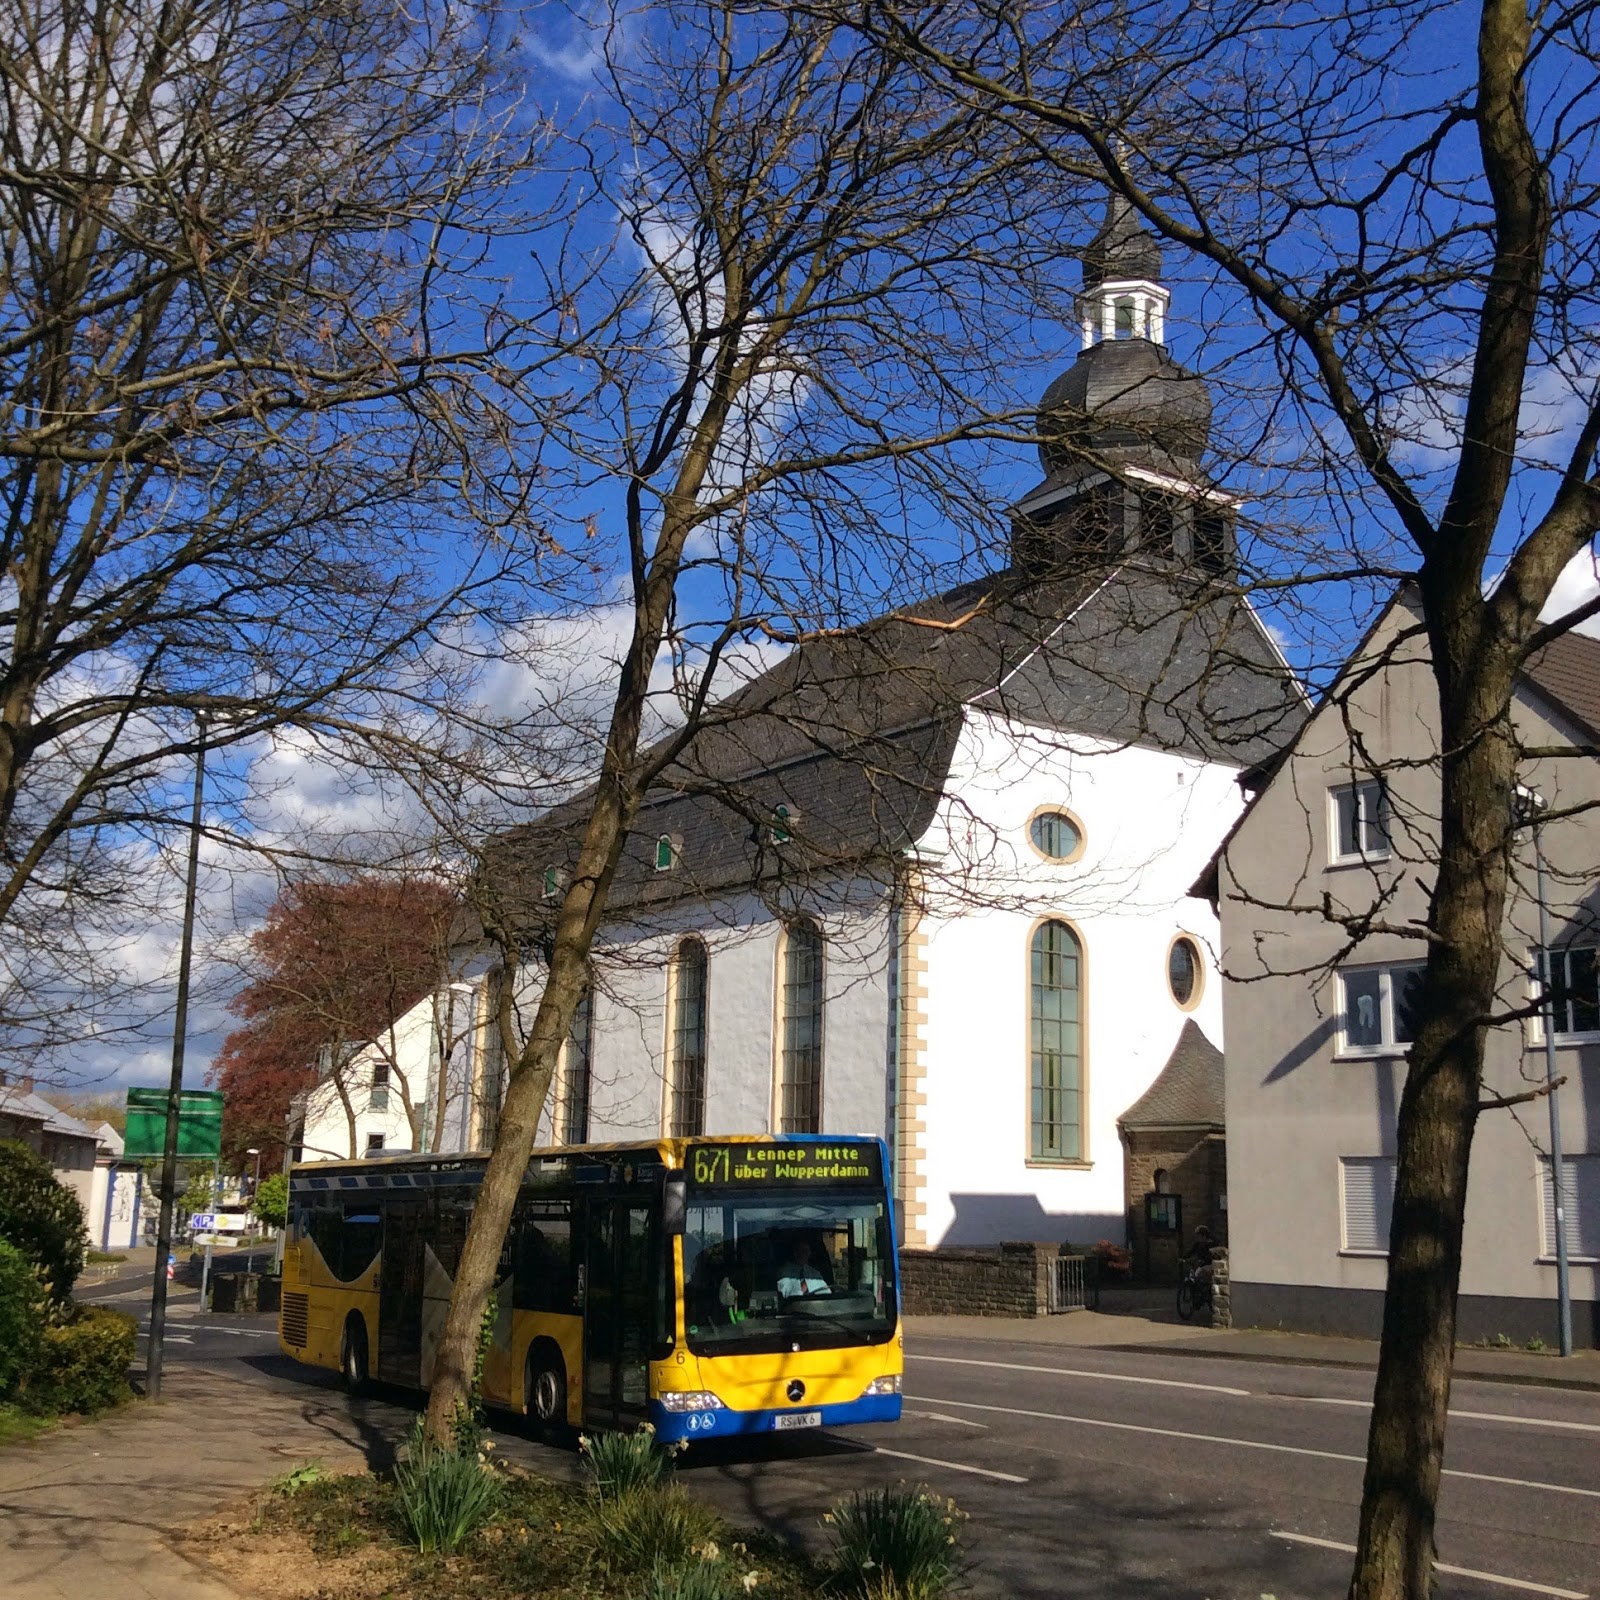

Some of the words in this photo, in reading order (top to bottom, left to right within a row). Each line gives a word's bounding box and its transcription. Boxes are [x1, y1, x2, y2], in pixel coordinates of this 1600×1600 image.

[747, 1148, 806, 1161] Lennep
[816, 1147, 859, 1160] Mitte
[694, 1148, 730, 1184] 671
[735, 1164, 768, 1178] über
[775, 1163, 869, 1179] Wupperdamm
[676, 1351, 685, 1365] 6
[781, 1416, 792, 1427] RS
[797, 1416, 808, 1425] VK
[810, 1414, 815, 1424] 6
